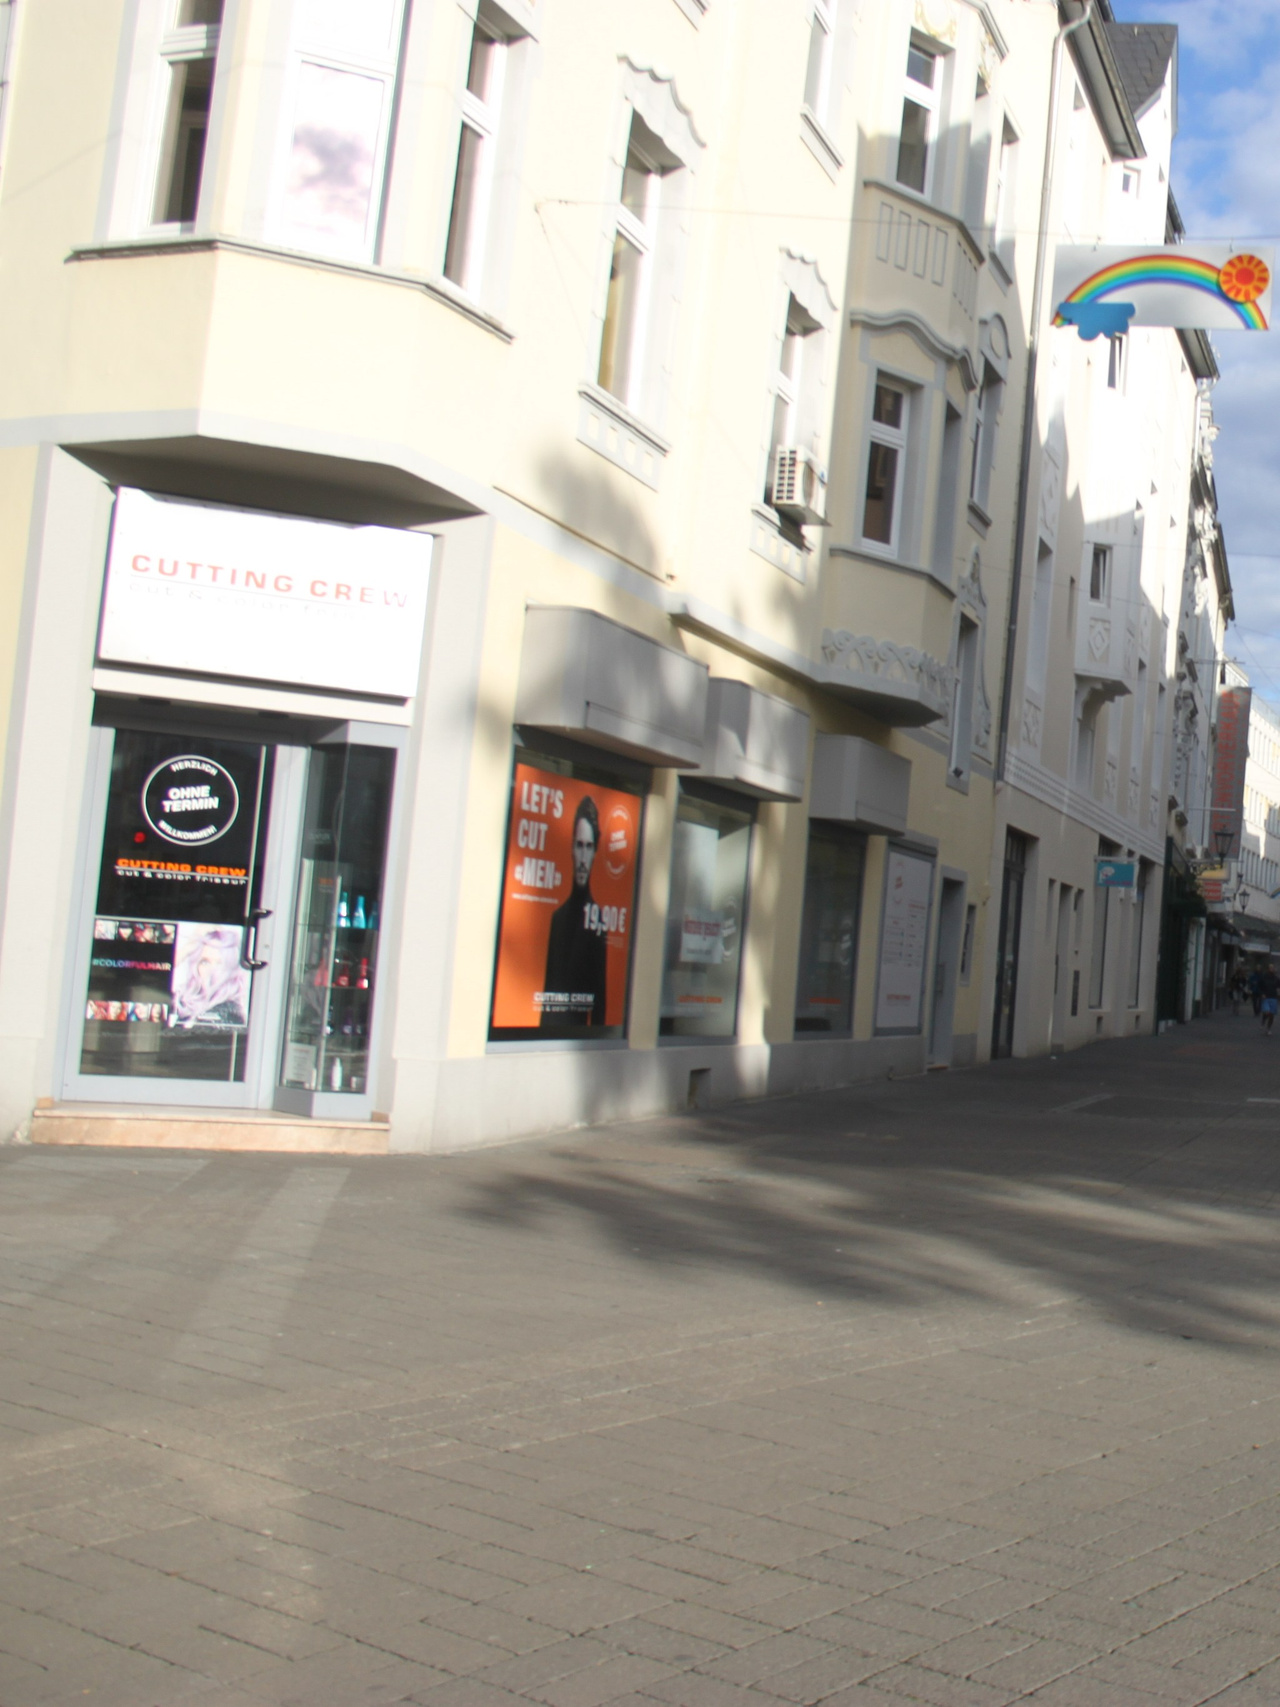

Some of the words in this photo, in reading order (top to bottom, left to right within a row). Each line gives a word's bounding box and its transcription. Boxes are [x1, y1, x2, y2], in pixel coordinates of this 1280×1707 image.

[131, 554, 294, 592] CUTTING
[309, 580, 408, 608] CREW
[170, 760, 218, 776] HERZLICH
[168, 785, 211, 800] OHNE
[521, 781, 564, 818] LET'S
[162, 797, 219, 813] TERMIN
[158, 819, 218, 840] WILLKOMMEN!
[518, 818, 548, 851] CUT
[116, 858, 192, 873] CUTTING
[195, 865, 247, 877] CREW
[117, 869, 140, 877] cut
[143, 871, 153, 879] &
[156, 872, 192, 881] color
[195, 875, 247, 886] friseur
[92, 958, 172, 972] #COLORFULHAIR
[533, 991, 570, 1002] CUTTING
[571, 992, 595, 1003] CREW
